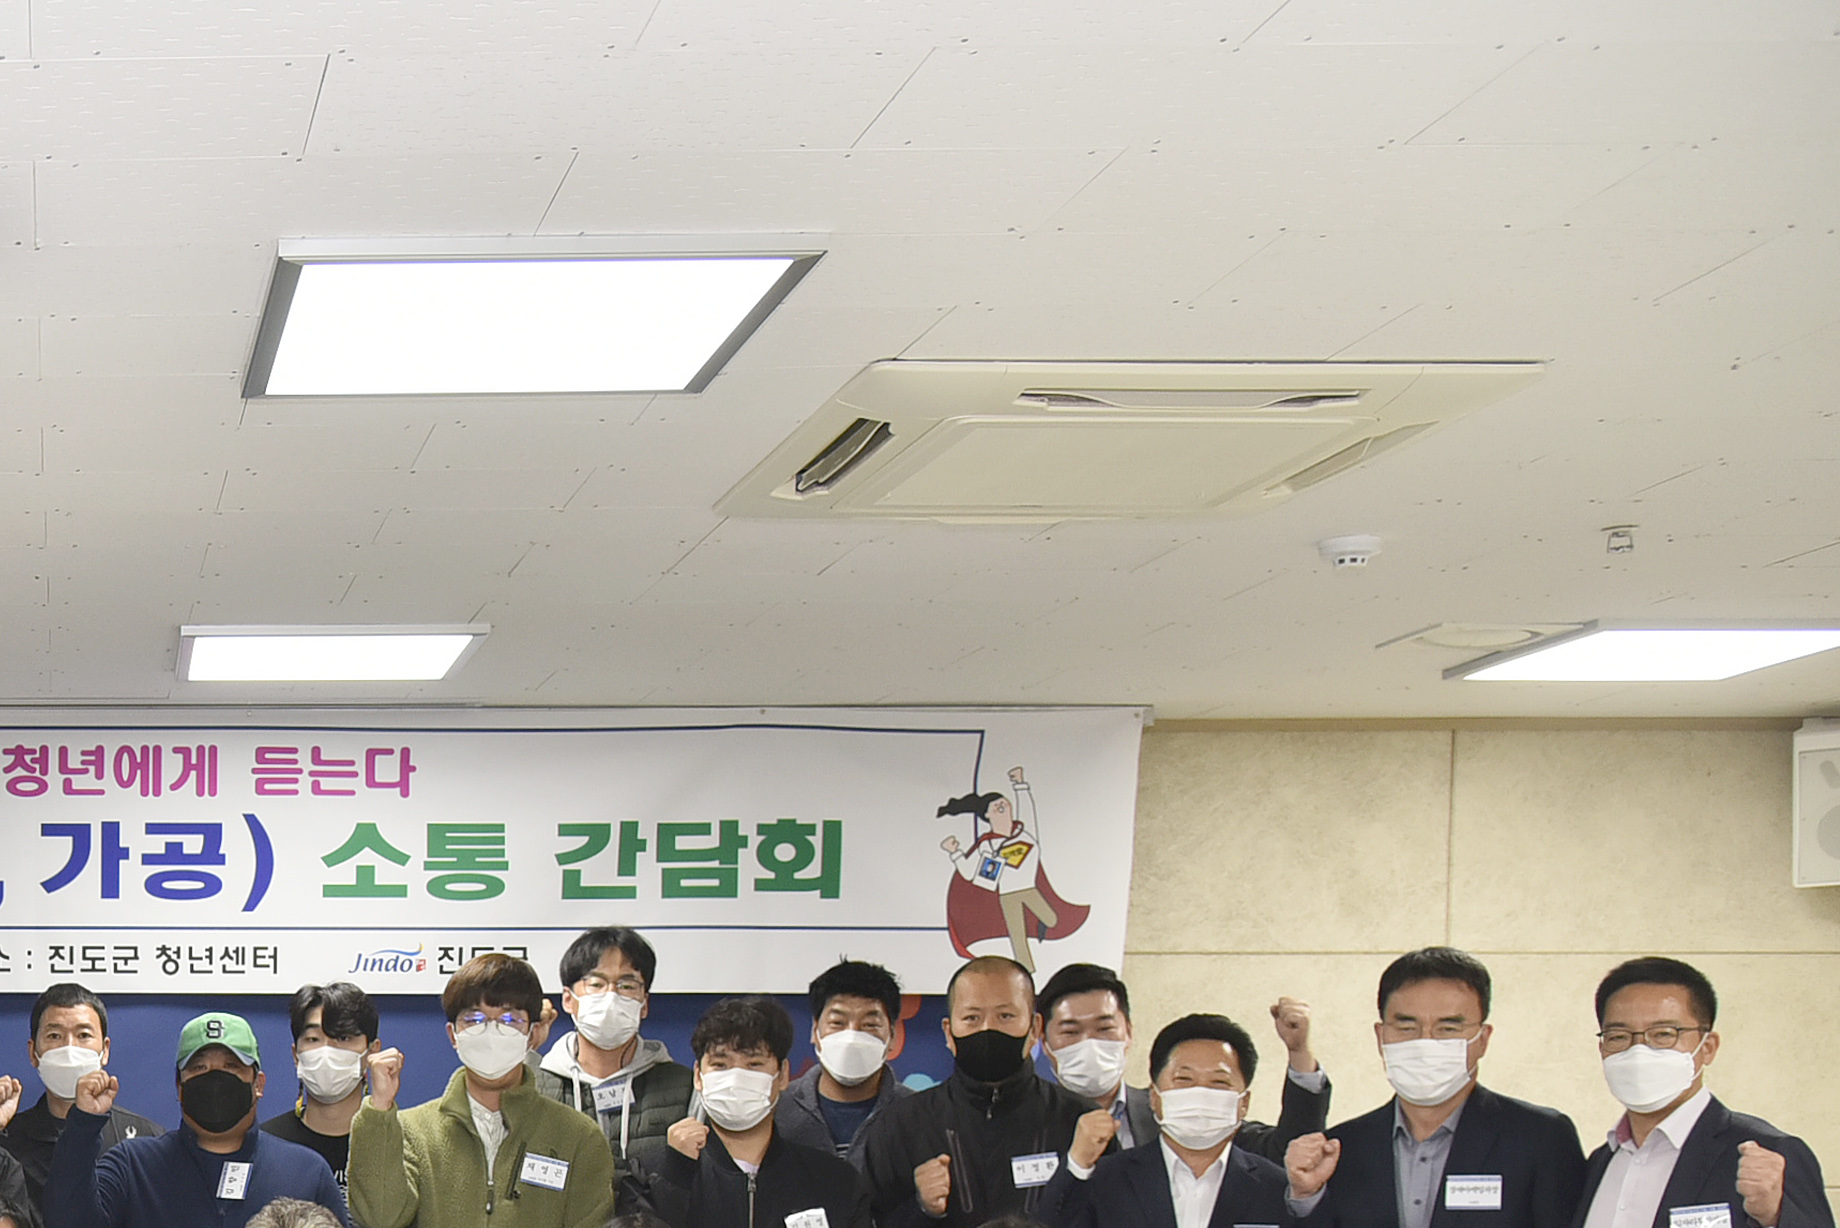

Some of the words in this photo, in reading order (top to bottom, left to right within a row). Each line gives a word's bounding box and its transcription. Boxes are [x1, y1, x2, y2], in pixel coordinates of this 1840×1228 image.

[2, 744, 218, 797] 청년에게
[251, 745, 417, 798] 듣는다
[40, 813, 275, 912] 가공)
[320, 822, 509, 901] 소통
[554, 818, 843, 900] 간담회
[48, 945, 140, 974] 진도군
[155, 944, 278, 975] 청년센터
[348, 953, 413, 973] Jindo
